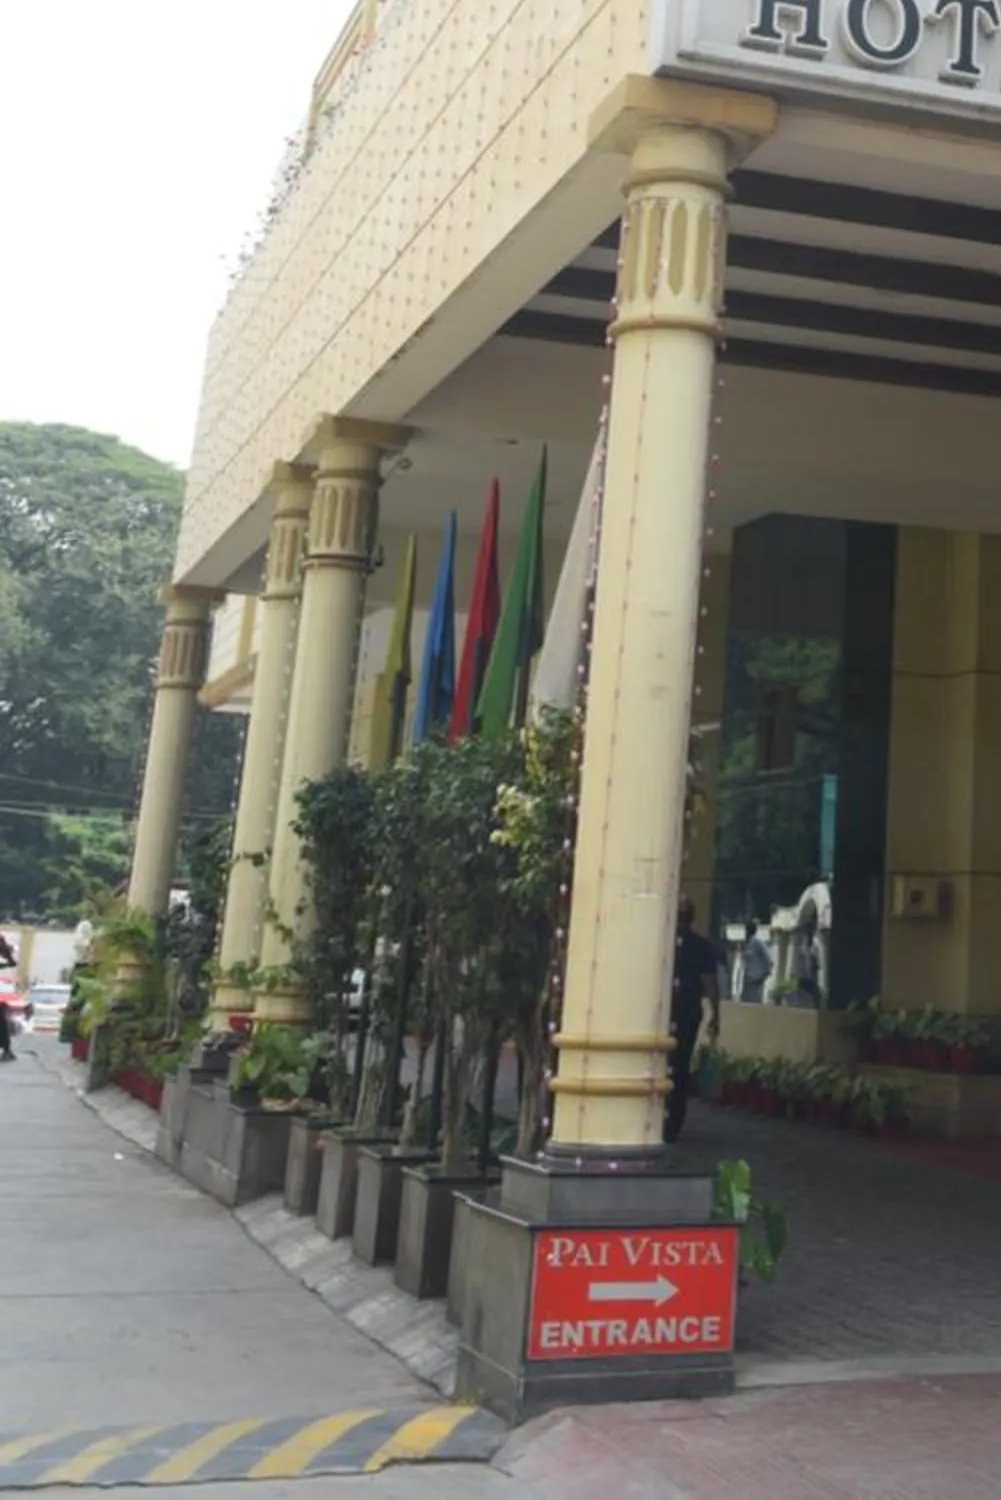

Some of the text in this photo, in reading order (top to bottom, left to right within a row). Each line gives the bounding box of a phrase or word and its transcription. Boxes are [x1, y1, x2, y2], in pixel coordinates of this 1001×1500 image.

[547, 1236, 724, 1267] PAI VISTA
[540, 1316, 721, 1349] ENTRANCE
